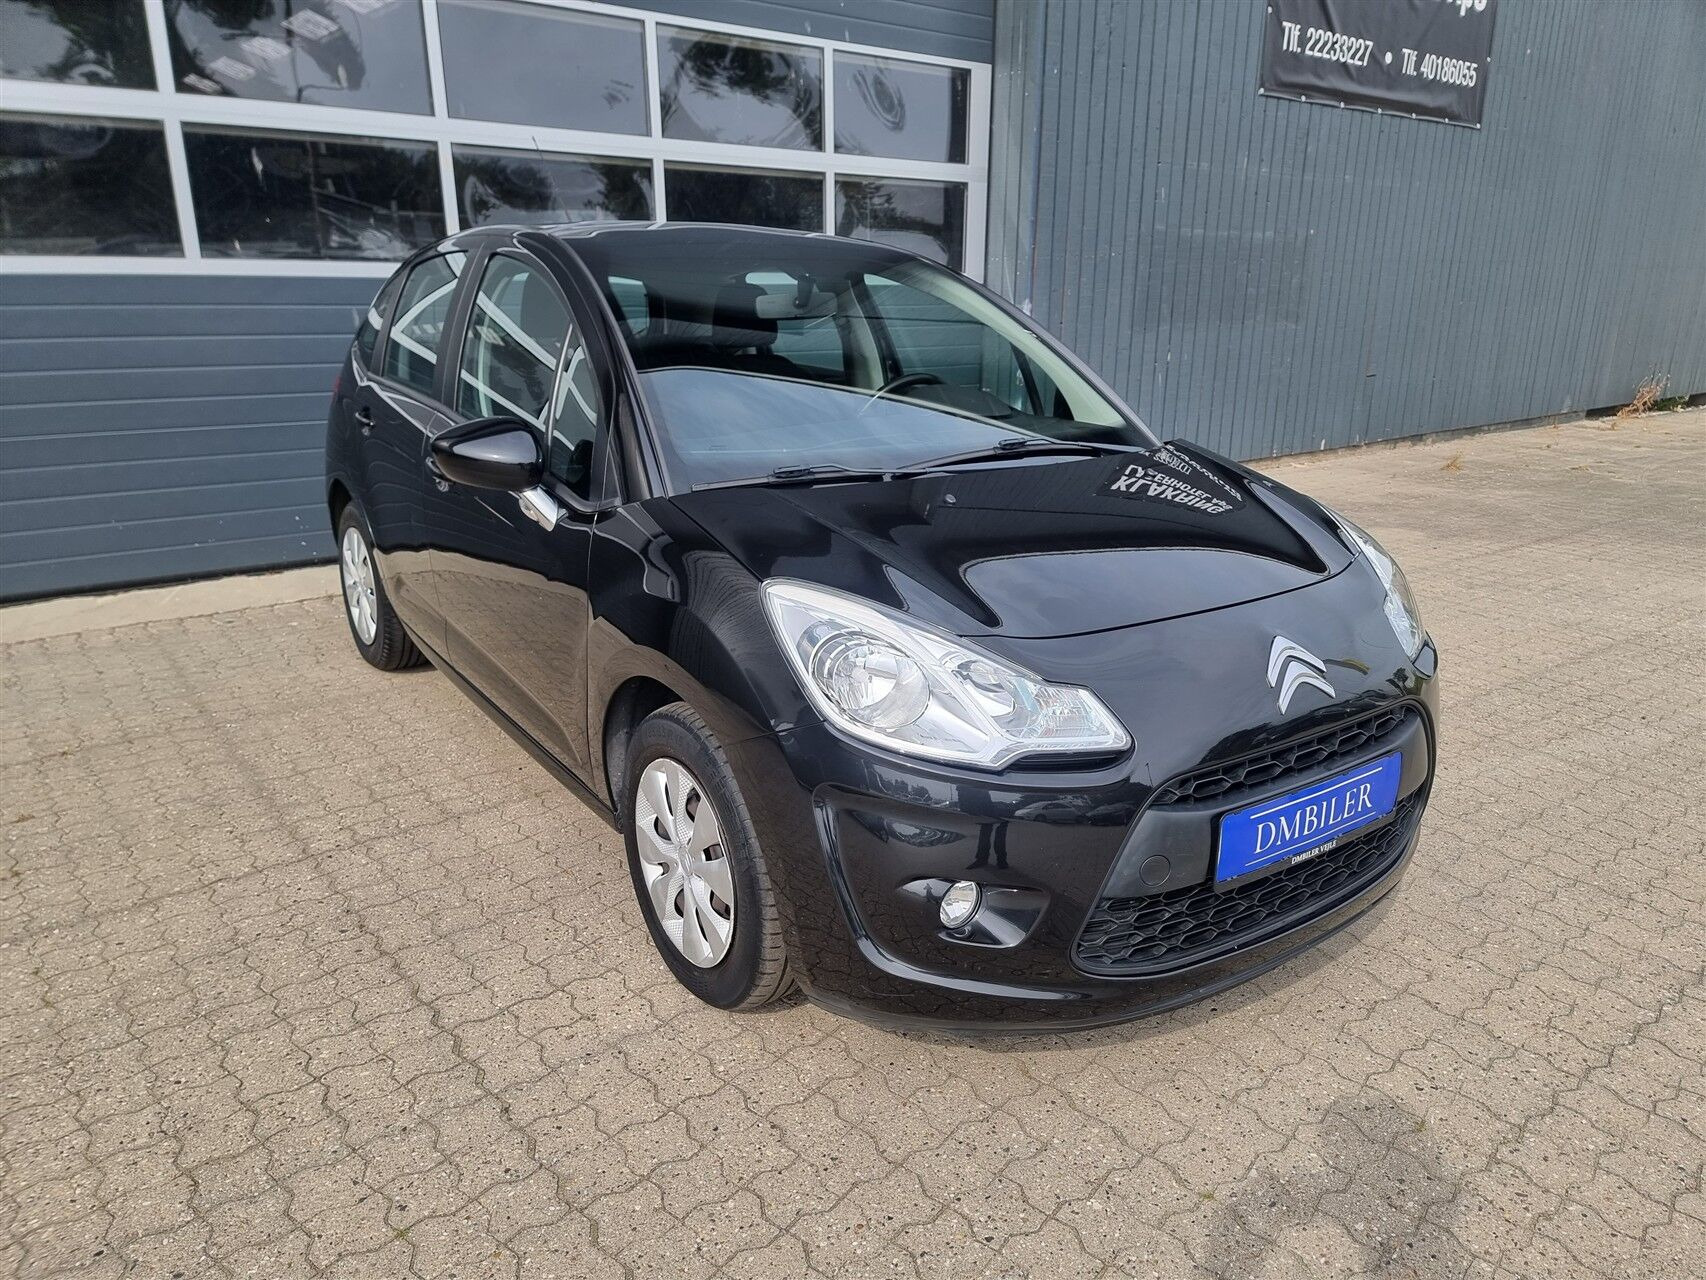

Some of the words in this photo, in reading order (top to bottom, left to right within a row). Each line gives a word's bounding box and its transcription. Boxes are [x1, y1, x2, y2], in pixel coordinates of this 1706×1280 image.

[1282, 21, 1301, 53] Tlf.
[1305, 27, 1374, 67] 22233227
[1402, 48, 1418, 76] Tlf.
[1420, 53, 1478, 88] 40186055
[1254, 783, 1372, 854] DMBILER
[1291, 847, 1320, 865] DMBILER
[1320, 840, 1337, 853] VEJLE
